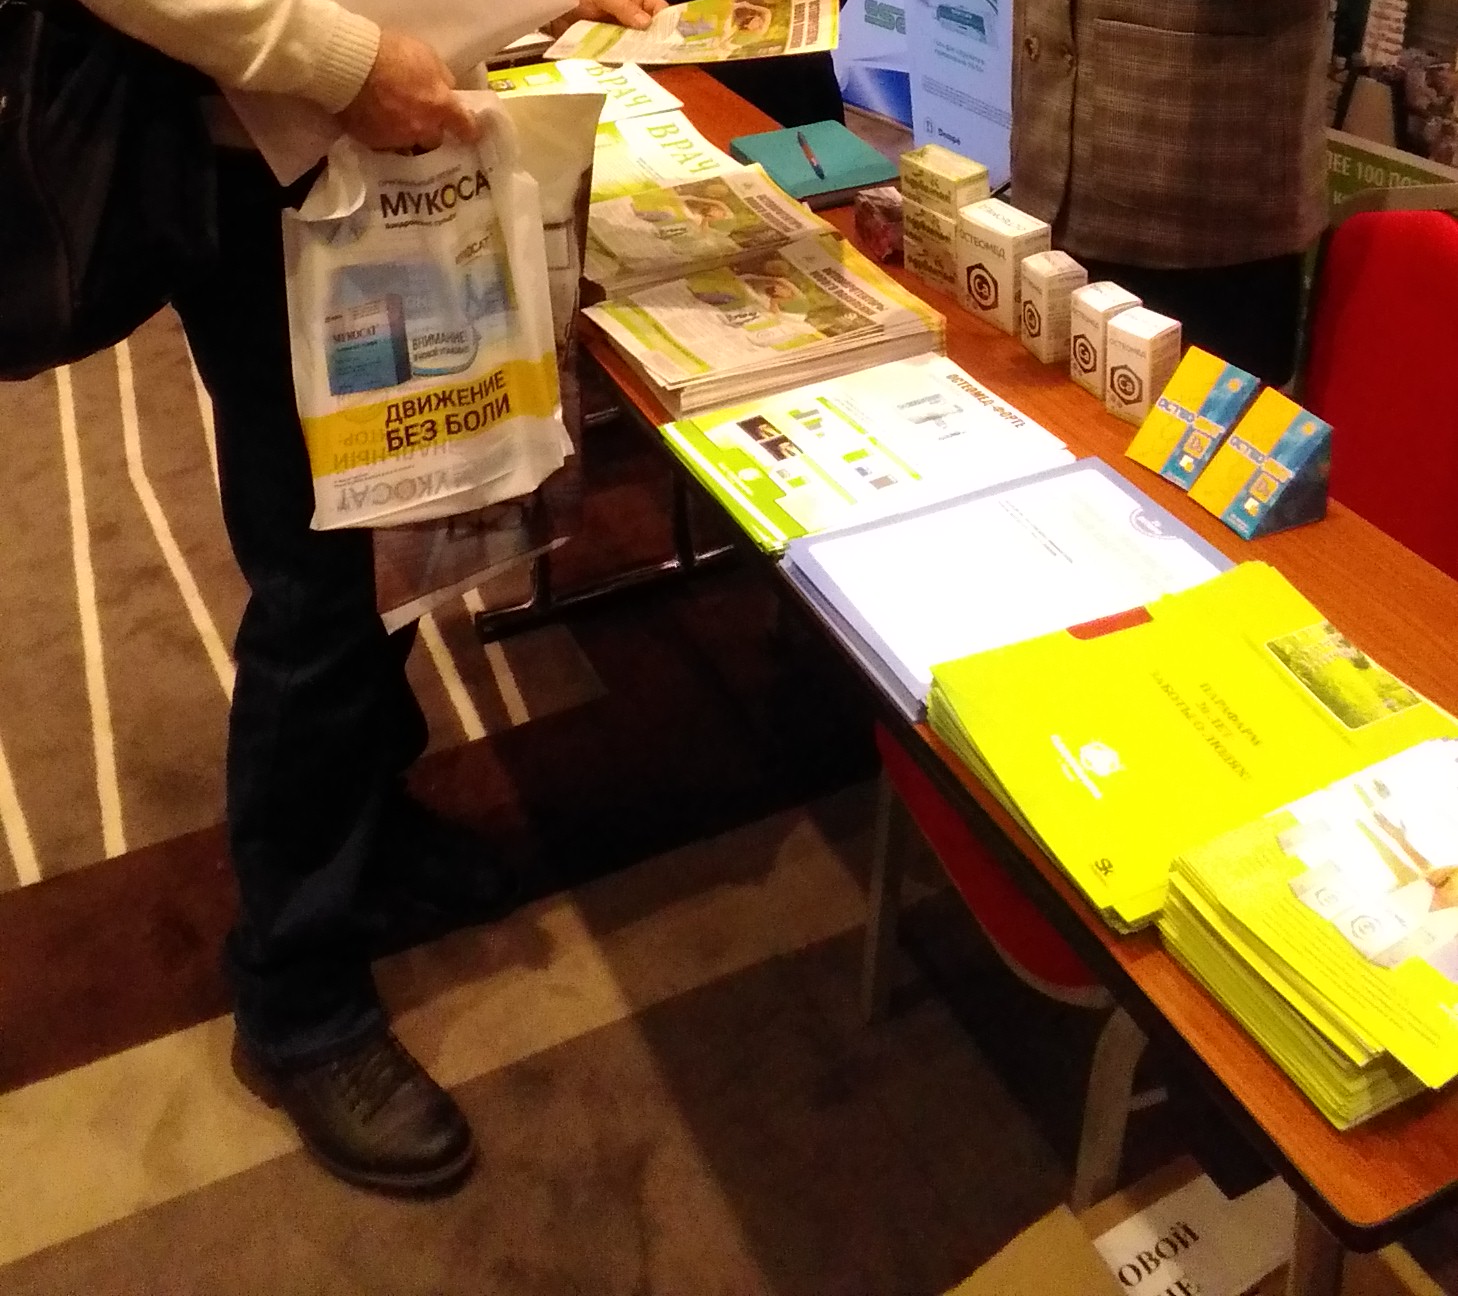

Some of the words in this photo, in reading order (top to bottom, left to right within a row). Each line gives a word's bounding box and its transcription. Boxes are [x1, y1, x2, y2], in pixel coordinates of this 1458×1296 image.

[646, 121, 721, 174] ВРАЧ
[1358, 161, 1384, 187] 100
[385, 370, 507, 428] ДВИЖЕНИЕ
[385, 419, 438, 452] БЕЗ
[445, 392, 511, 436] БОЛИ
